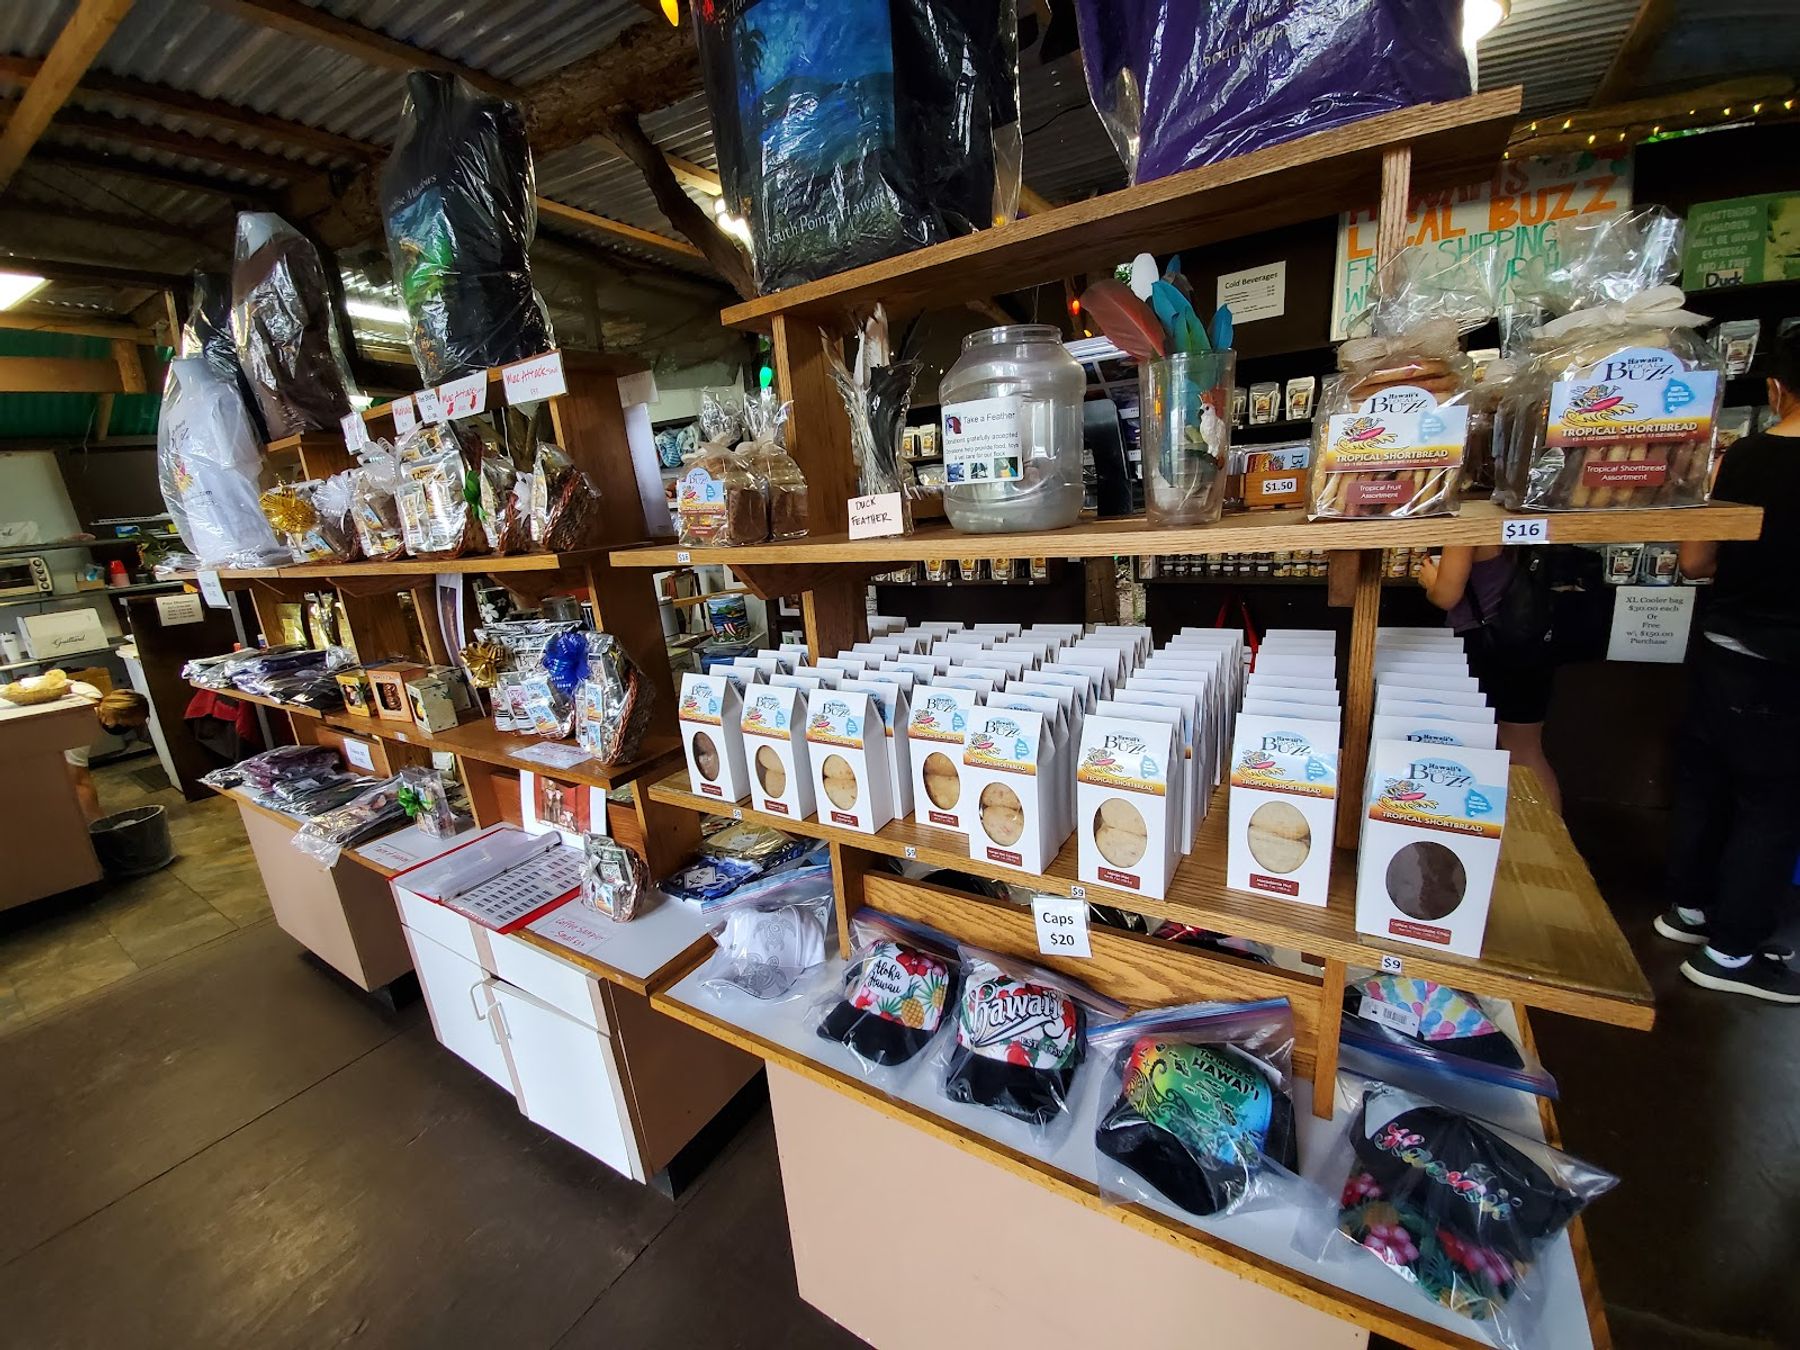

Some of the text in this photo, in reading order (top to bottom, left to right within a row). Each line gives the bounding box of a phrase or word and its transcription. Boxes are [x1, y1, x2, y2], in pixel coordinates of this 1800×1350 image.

[1489, 175, 1618, 231] BUZZ
[1225, 272, 1278, 289] Cold Beverages
[1705, 271, 1743, 287] Duck
[1627, 357, 1663, 365] Hawaii's
[963, 416, 979, 424] Take
[986, 412, 1016, 421] Feather
[992, 431, 1019, 440] accepted
[1562, 423, 1698, 437] TROPICAL SHORTBREAD
[1336, 450, 1448, 463] TROPICAL SHORTBREAD
[1587, 464, 1666, 474] Tropical Shortbread
[1265, 481, 1293, 492] $1.50
[855, 497, 876, 511] DUCK
[851, 512, 892, 526] FEATHER
[1506, 523, 1540, 539] $16
[1104, 735, 1146, 755] BUZZ
[1261, 736, 1312, 757] BUZZ
[1429, 763, 1461, 772] Hawaii's
[1406, 763, 1472, 787] BUZZ
[1086, 776, 1154, 791] TROPICAL SHORTBREAD
[1241, 778, 1321, 795] TROPICAL SHORTBREAD
[1382, 811, 1483, 832] TROPICAL SHORTBREAD
[1073, 887, 1083, 896] $9
[1043, 912, 1074, 927] Caps
[1051, 933, 1075, 946] $20
[874, 960, 902, 981] Aloha
[1384, 957, 1400, 970] $9
[867, 972, 902, 995] Hawaii
[1021, 1036, 1039, 1049] EST
[1200, 1049, 1214, 1061] The
